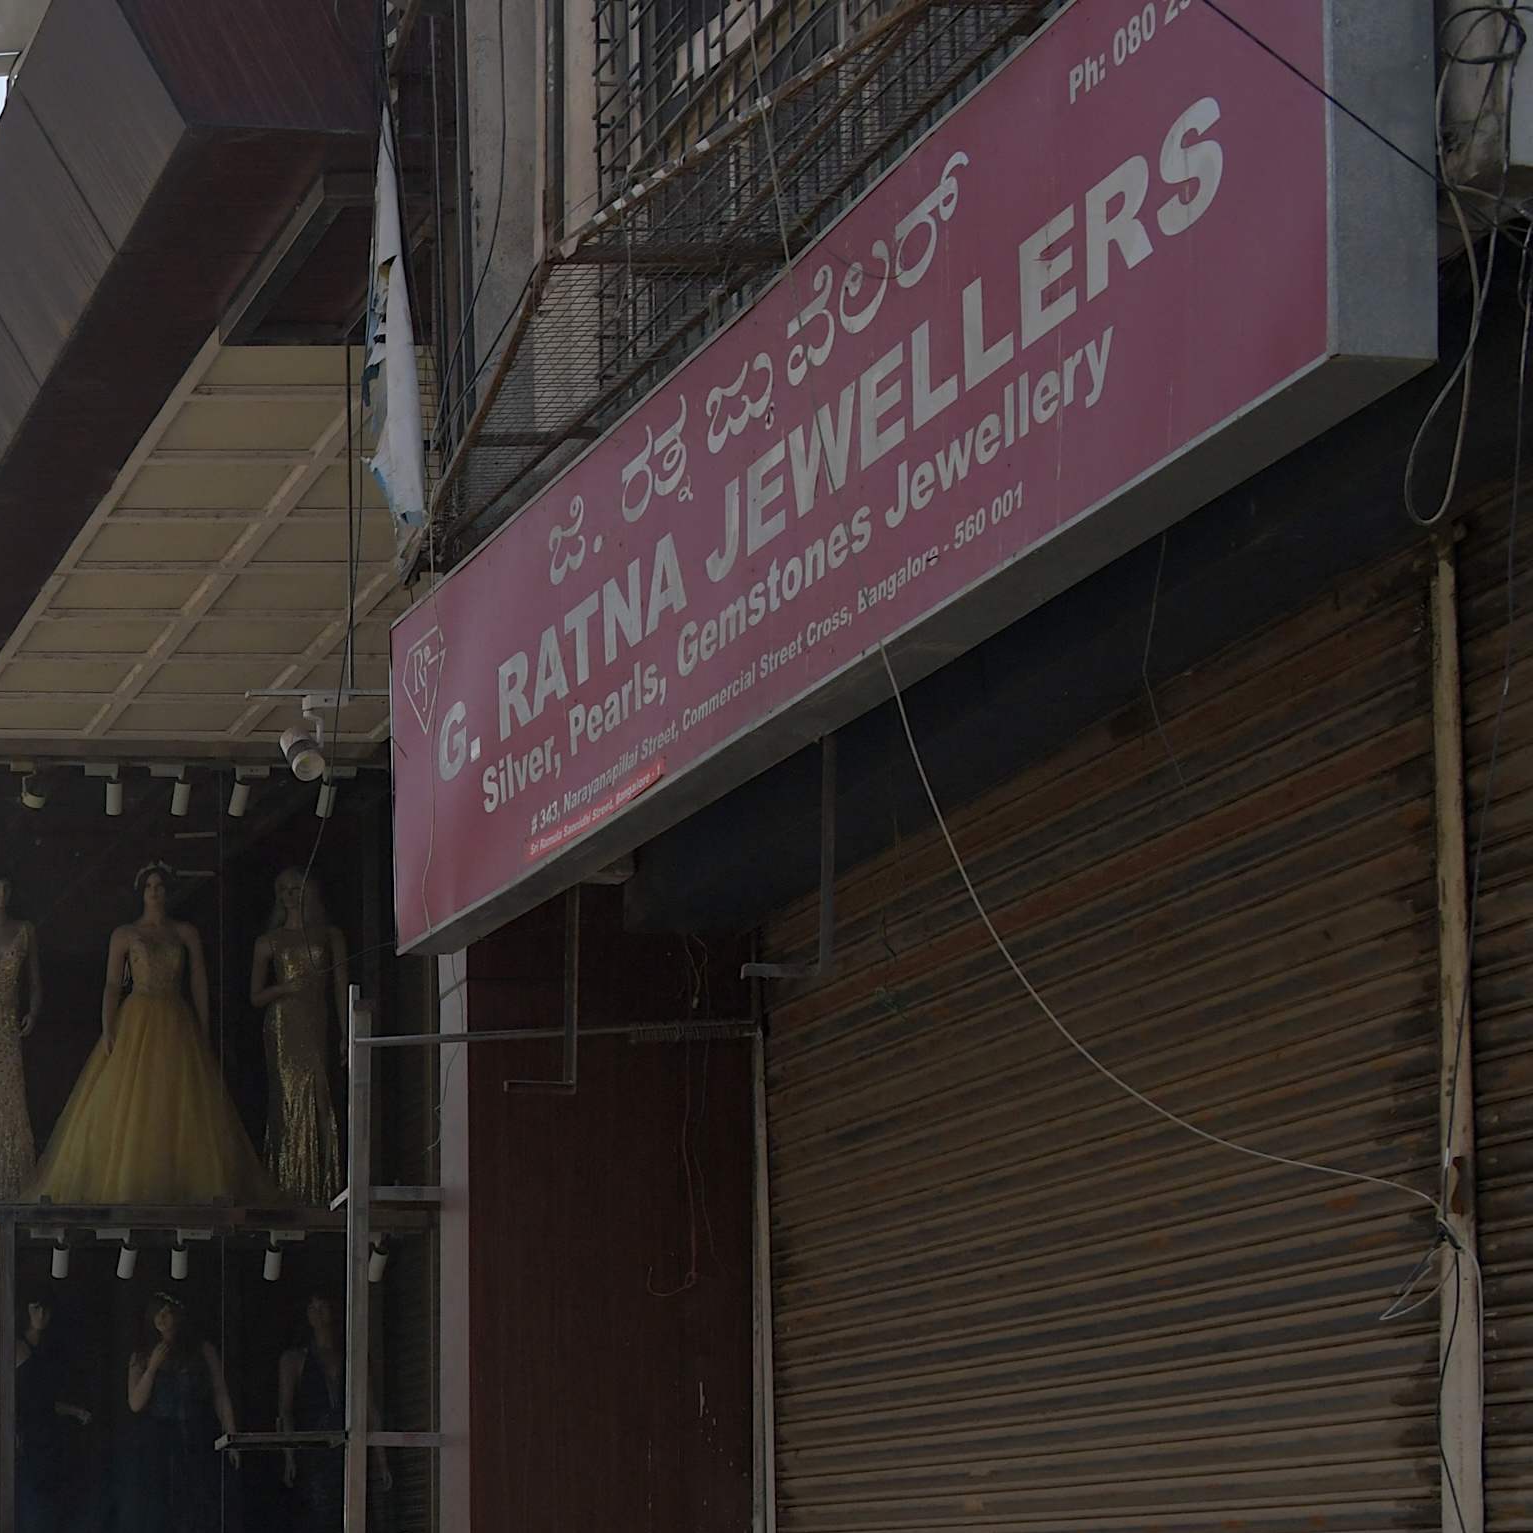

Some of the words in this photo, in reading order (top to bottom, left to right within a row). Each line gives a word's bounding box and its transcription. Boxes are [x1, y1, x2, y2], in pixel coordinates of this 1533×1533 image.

[1069, 53, 1106, 104] Ph:
[1113, 8, 1156, 66] 080
[438, 700, 482, 782] G.
[497, 531, 687, 742] RATNA
[705, 96, 1224, 584] JEWELLERS
[482, 734, 563, 813] Silver,
[569, 659, 667, 757] Pearls,
[677, 505, 872, 678] Gemstones
[884, 326, 1114, 528] Jewellery
[563, 745, 638, 815] Narayanapillai
[641, 722, 679, 765] Street,
[682, 663, 756, 729] Commercial
[760, 633, 803, 678] Street
[806, 605, 853, 647] Cross,
[857, 546, 939, 615] Bangalore
[954, 507, 986, 550] 560
[990, 484, 1024, 526] 001
